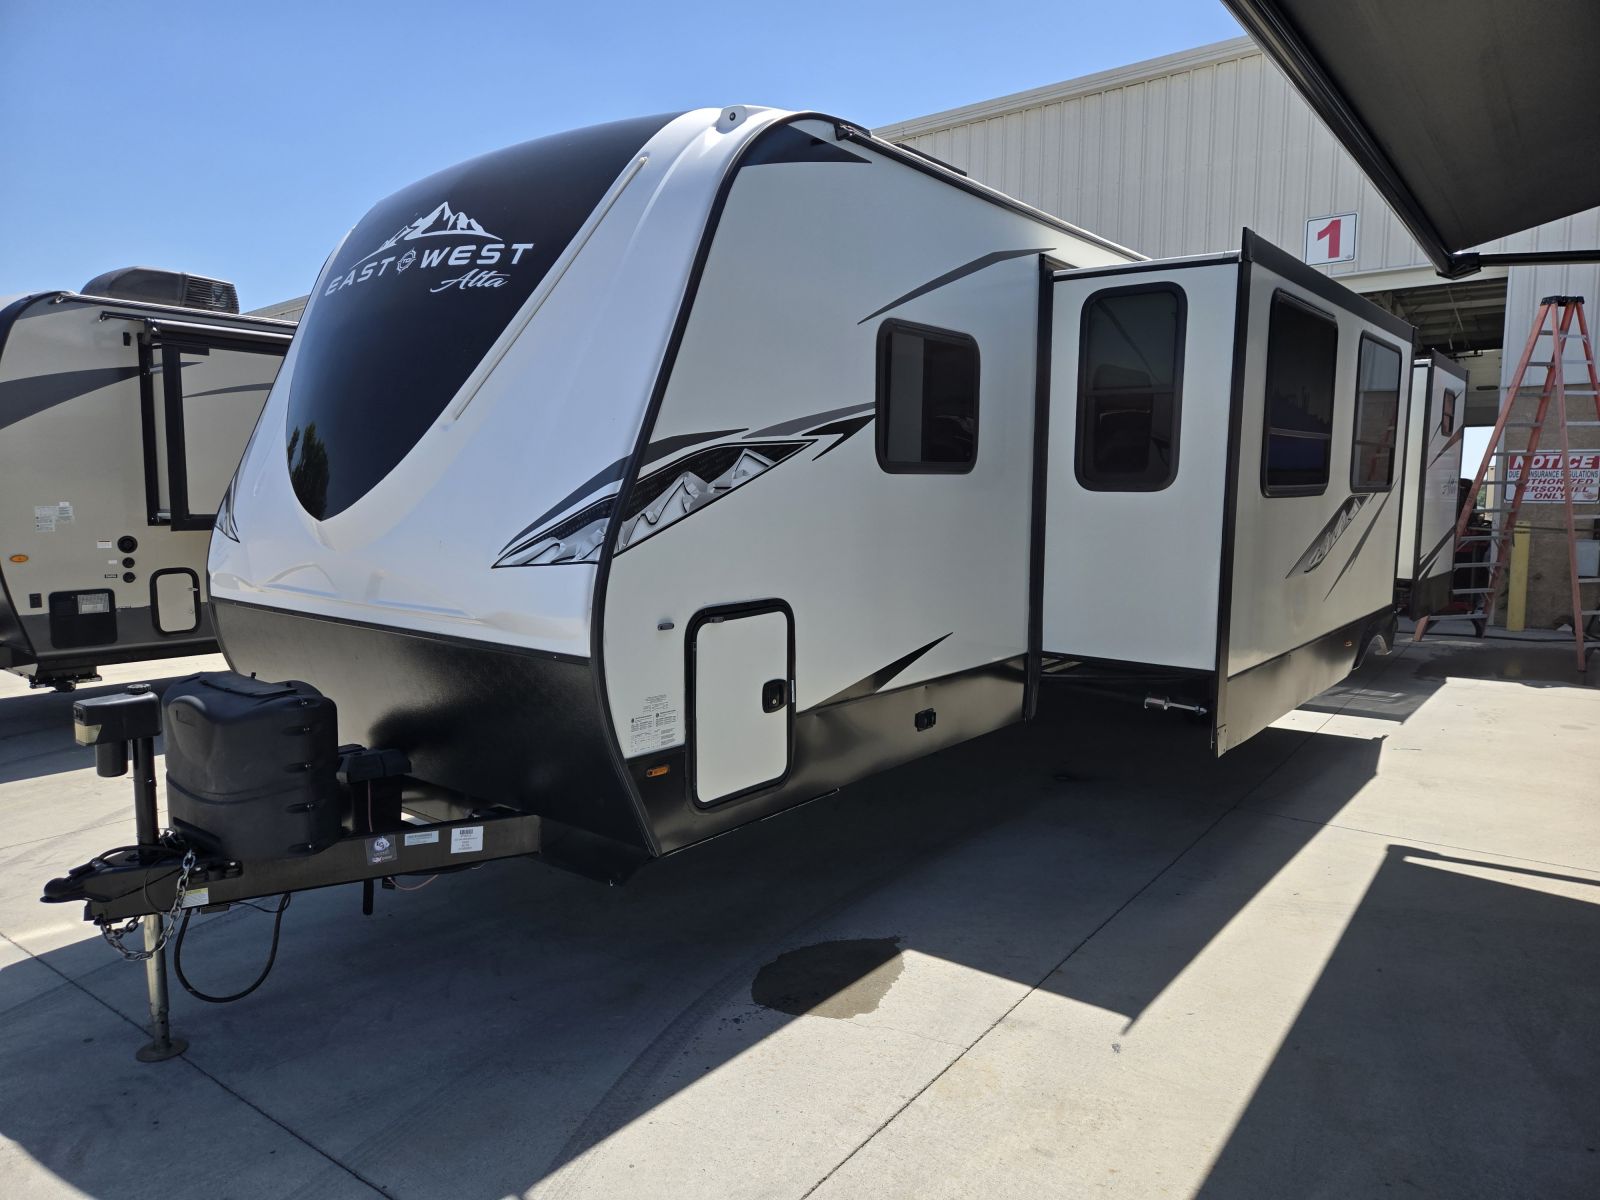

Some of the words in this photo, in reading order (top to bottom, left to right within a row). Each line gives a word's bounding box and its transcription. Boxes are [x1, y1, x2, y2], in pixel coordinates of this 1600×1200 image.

[1317, 219, 1341, 259] 1
[324, 256, 396, 297] EAST
[420, 243, 535, 269] WEST
[429, 268, 511, 293] Alta
